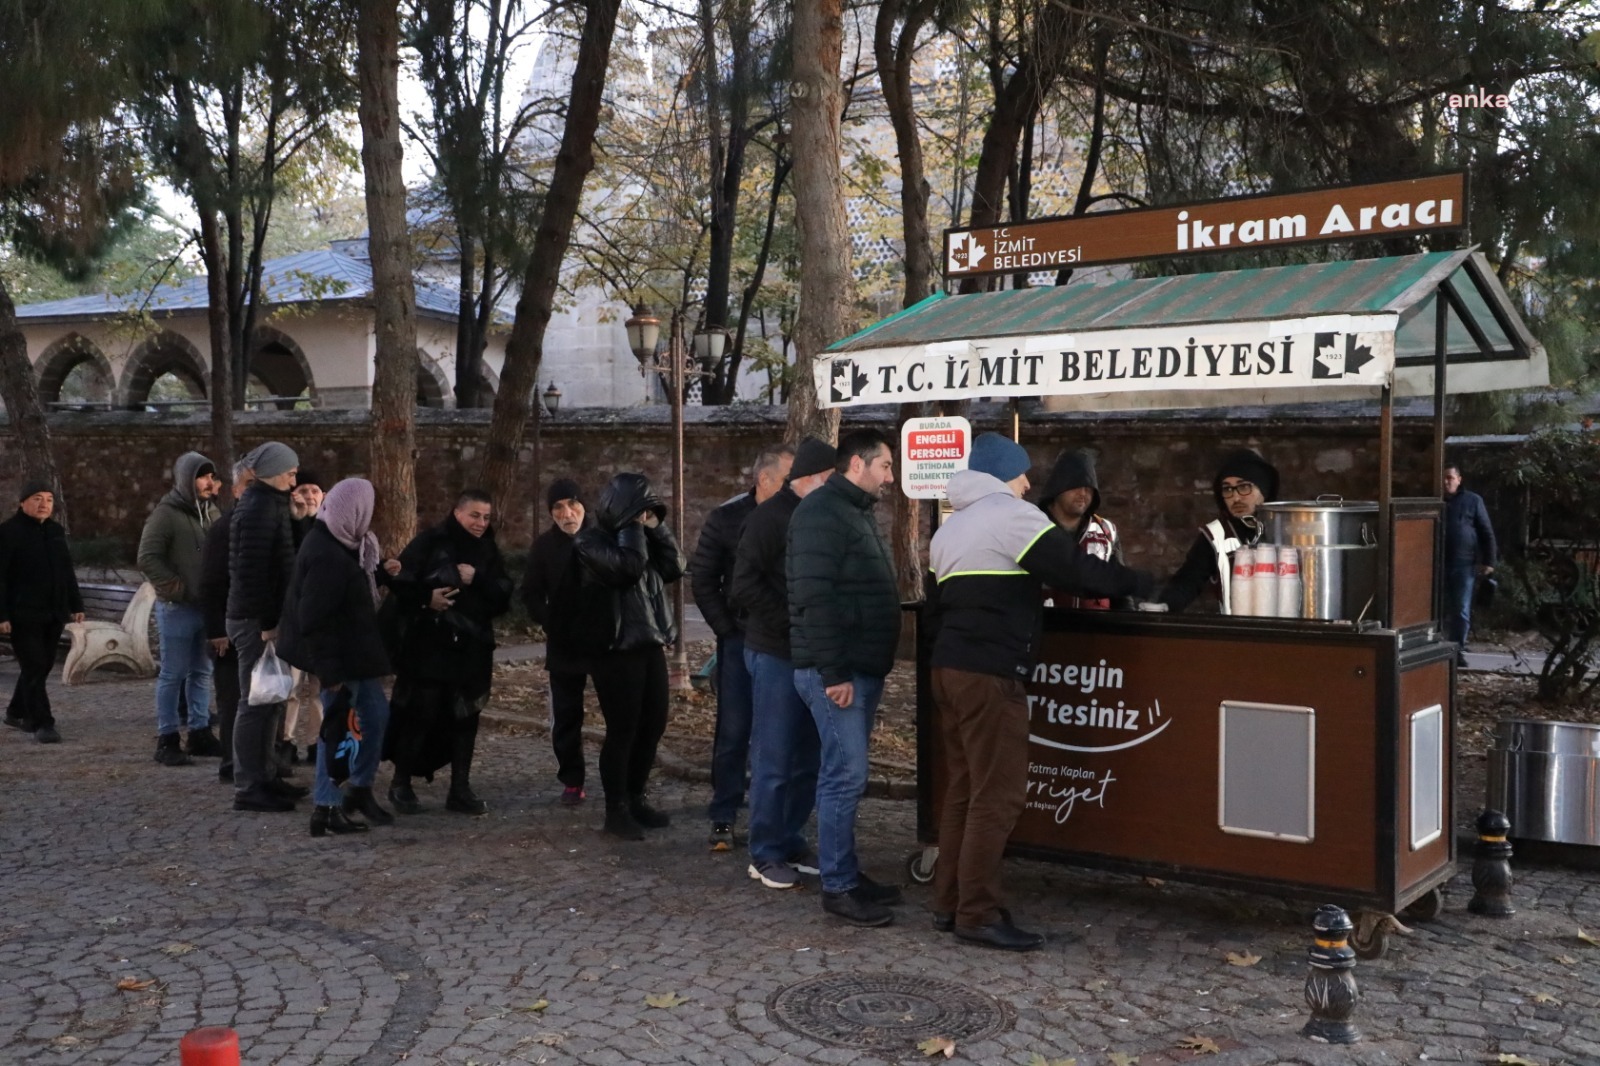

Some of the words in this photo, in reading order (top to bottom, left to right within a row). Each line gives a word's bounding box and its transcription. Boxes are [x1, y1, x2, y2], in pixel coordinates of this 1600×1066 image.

[992, 228, 1011, 238] T.C.
[1177, 210, 1307, 250] İkram
[1319, 199, 1453, 235] Aracı
[993, 236, 1036, 254] İZMİT
[878, 363, 934, 394] T.C.
[1059, 336, 1295, 382] BELEDİYESİ
[919, 422, 952, 430] BURADA
[915, 431, 956, 444] ENGELLİ
[910, 448, 961, 459] PERSONEL
[917, 461, 955, 470] İSTİHDAM
[1027, 695, 1140, 731] T'tesiniz
[1028, 762, 1058, 776] Fatma
[1060, 765, 1096, 780] Kaplan
[1026, 769, 1117, 824] rriyet
